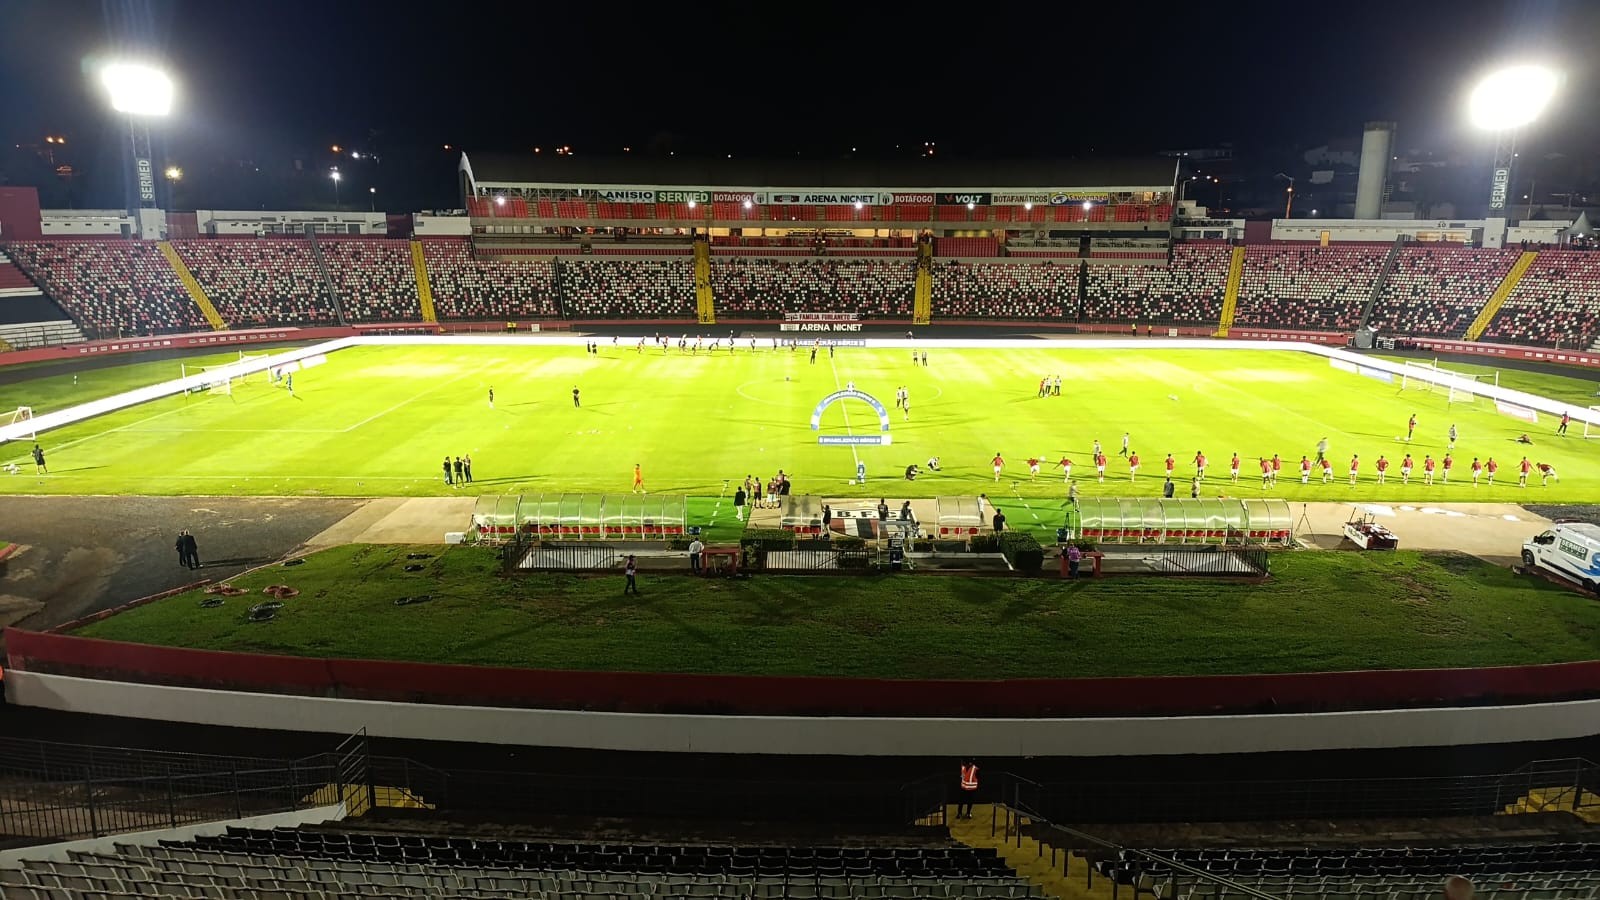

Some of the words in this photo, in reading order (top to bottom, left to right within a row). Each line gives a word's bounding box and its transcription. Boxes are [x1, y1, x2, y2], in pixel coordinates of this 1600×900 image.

[138, 160, 153, 199] SERMED
[1491, 169, 1508, 208] SERMED
[606, 191, 653, 199] ANISIO
[659, 192, 709, 203] SERMED
[713, 193, 752, 202] BOTAFOGO
[803, 195, 837, 203] ARENA
[840, 195, 875, 203] NICNET
[895, 195, 933, 203] BOTAFOGO
[955, 195, 983, 204] VOLT
[993, 193, 1048, 203] BOTAFANÁTICOS
[801, 323, 831, 331] ARENA
[833, 323, 863, 331] NICNET
